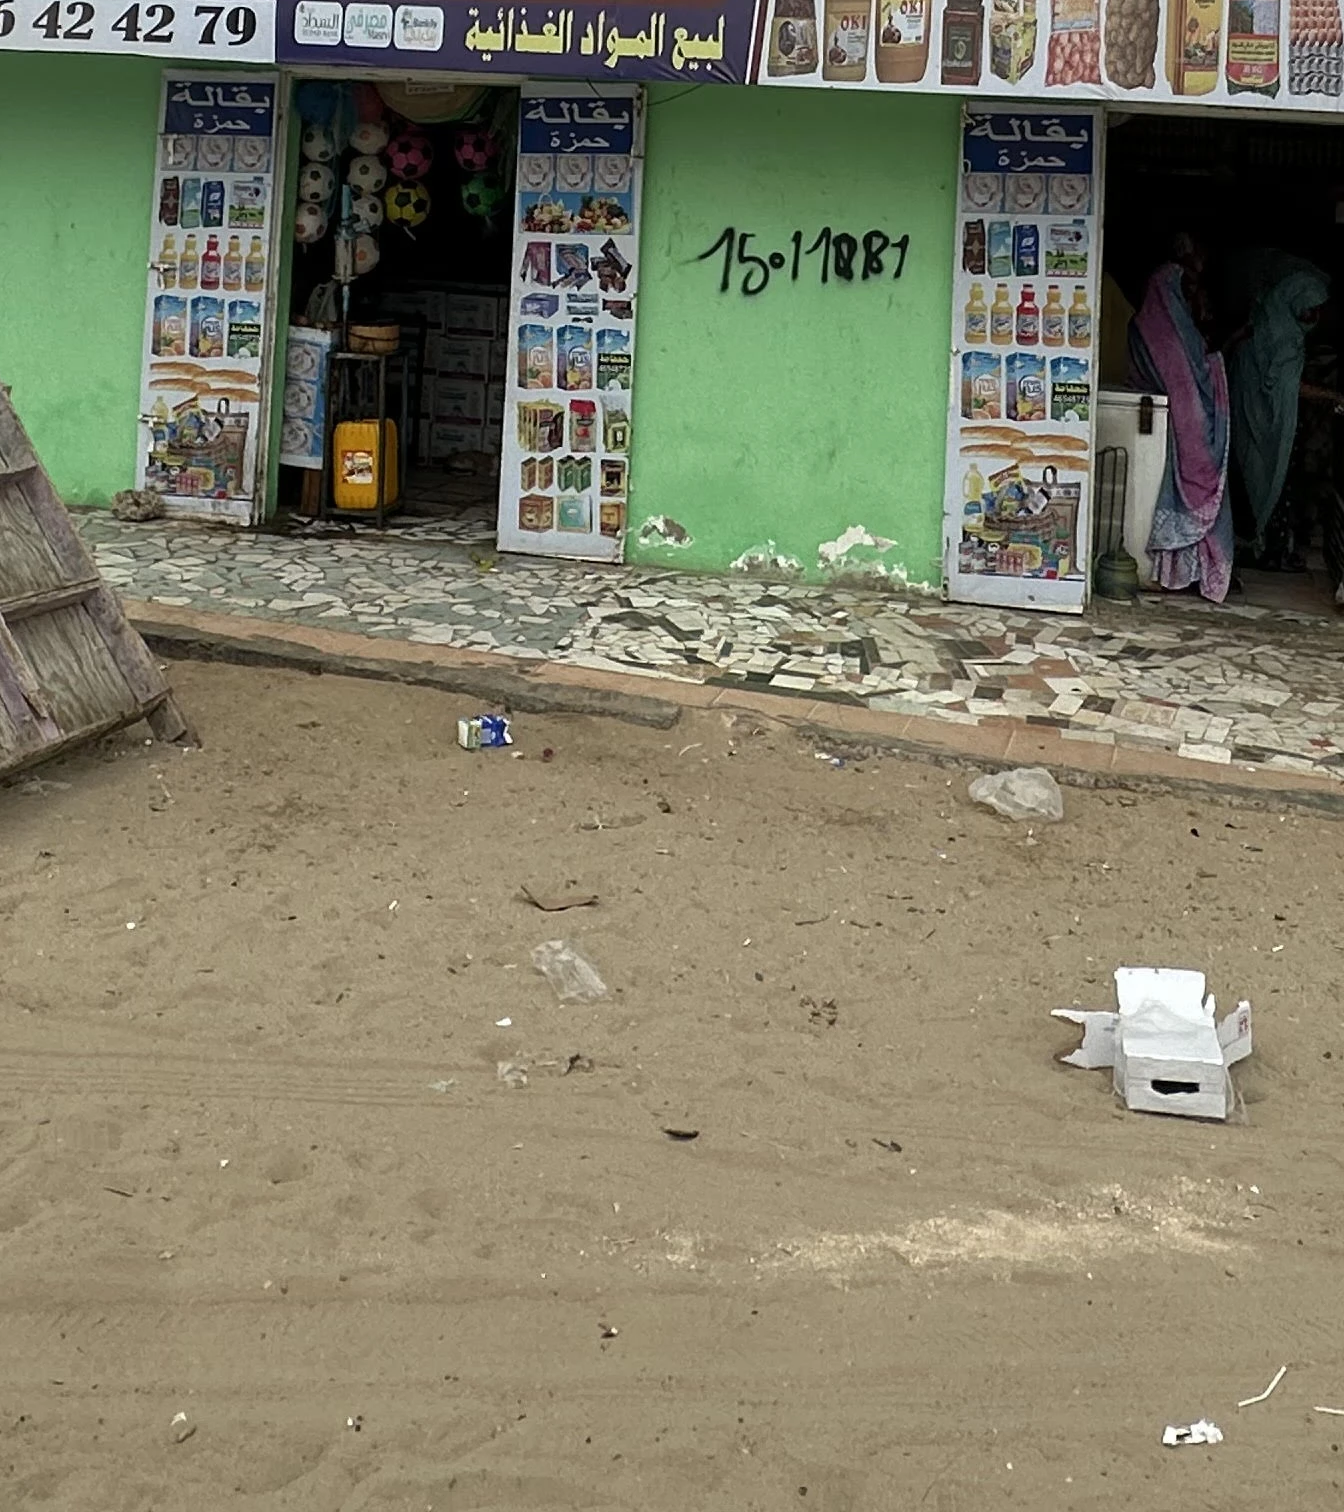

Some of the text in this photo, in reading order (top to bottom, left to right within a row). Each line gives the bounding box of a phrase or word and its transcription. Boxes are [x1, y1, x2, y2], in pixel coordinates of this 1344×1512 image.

[32, 0, 96, 42] 42
[111, 3, 176, 45] 42
[193, 6, 257, 48] 79
[464, 5, 726, 72] لبيع المواد الغذائية
[170, 81, 271, 114] بقالة
[193, 113, 251, 133] حمزة
[524, 98, 630, 130] بقالة
[549, 130, 610, 152] حمزة
[969, 114, 1089, 149] بقالة
[997, 149, 1067, 172] حمزة
